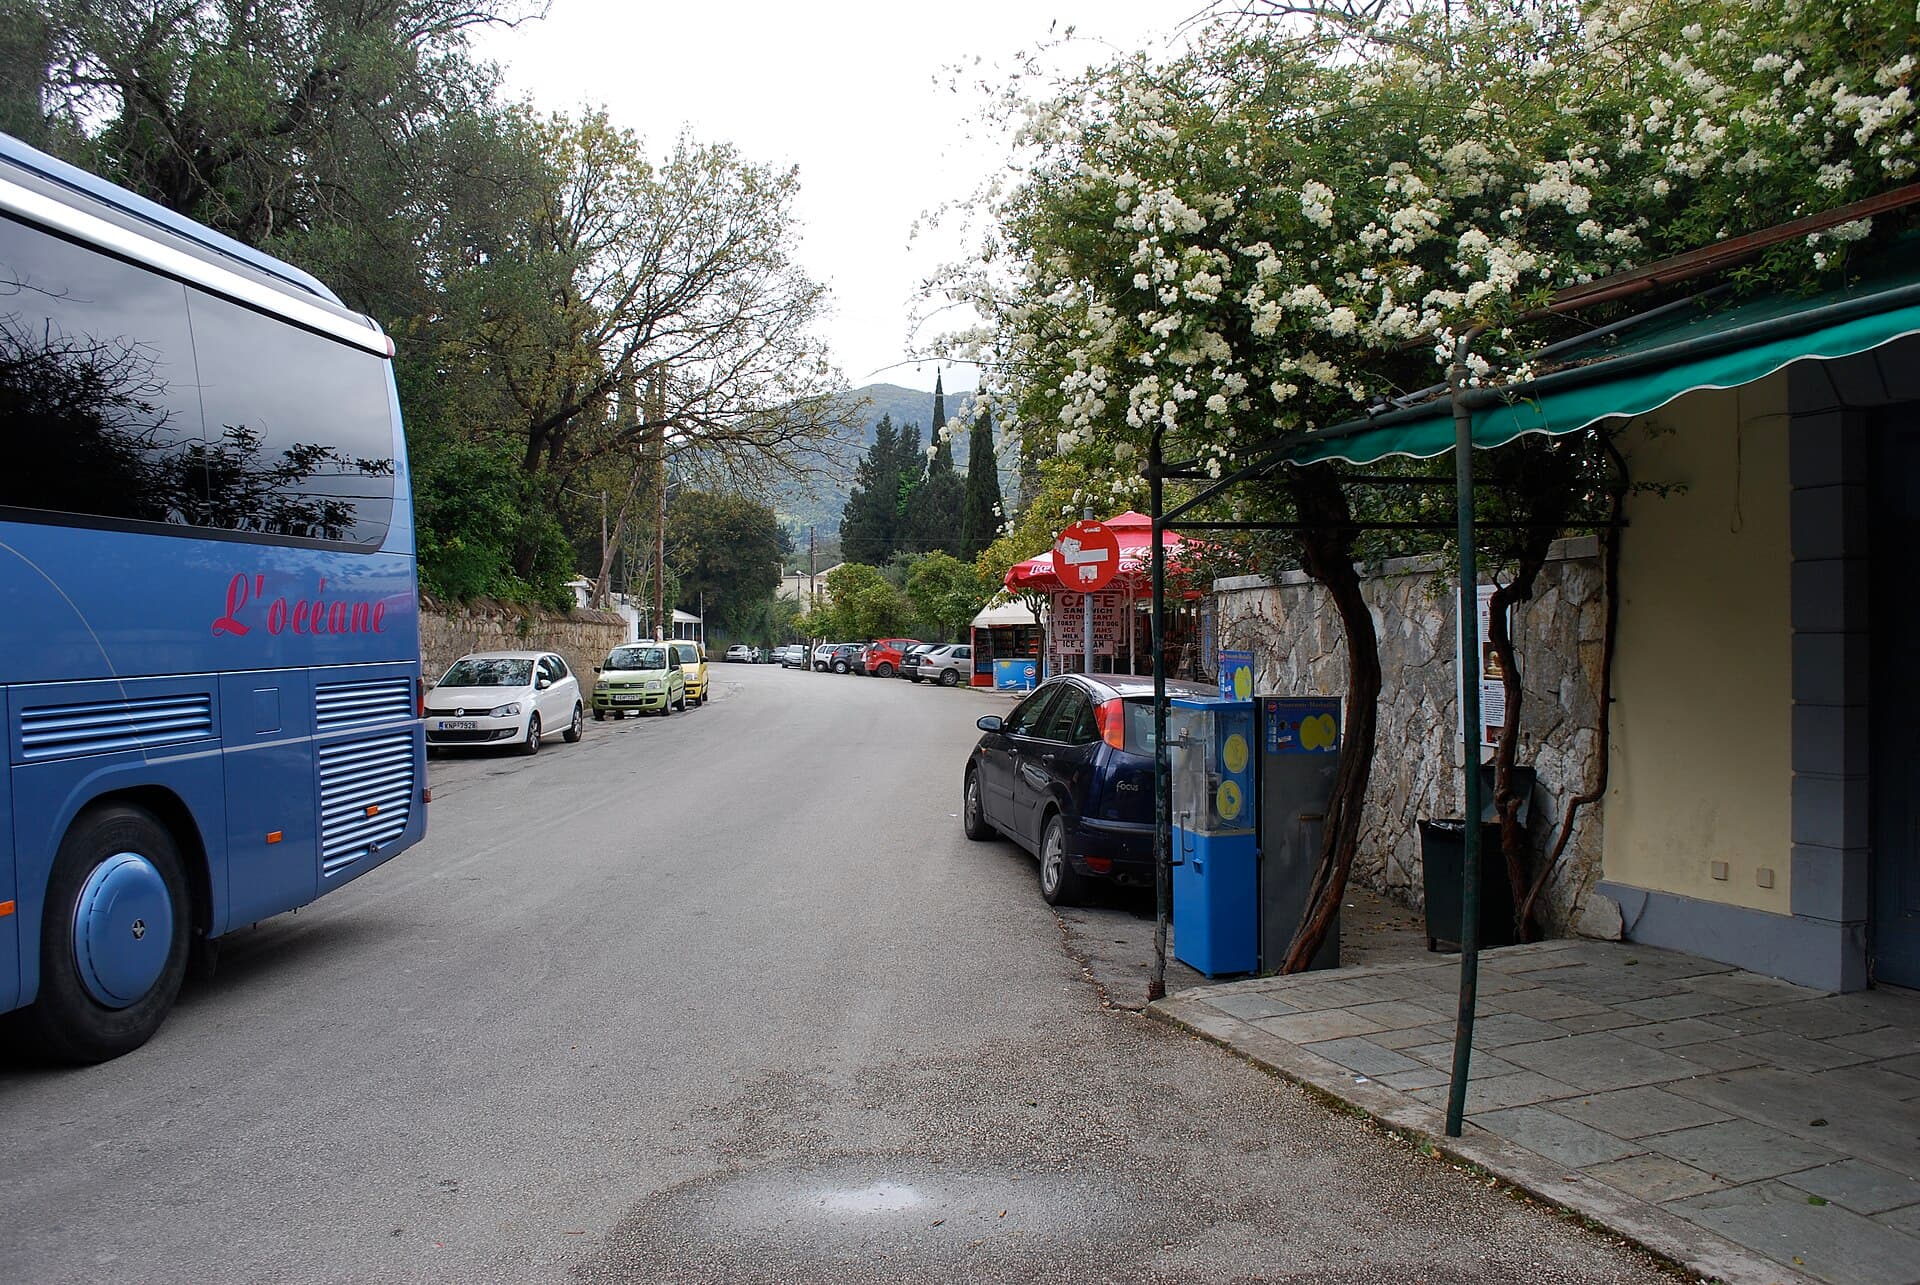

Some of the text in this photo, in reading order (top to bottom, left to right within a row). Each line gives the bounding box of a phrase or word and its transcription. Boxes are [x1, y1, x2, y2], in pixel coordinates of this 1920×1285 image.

[211, 572, 387, 637] L'océane
[1061, 595, 1115, 608] CAFE
[1062, 640, 1076, 648] ICE
